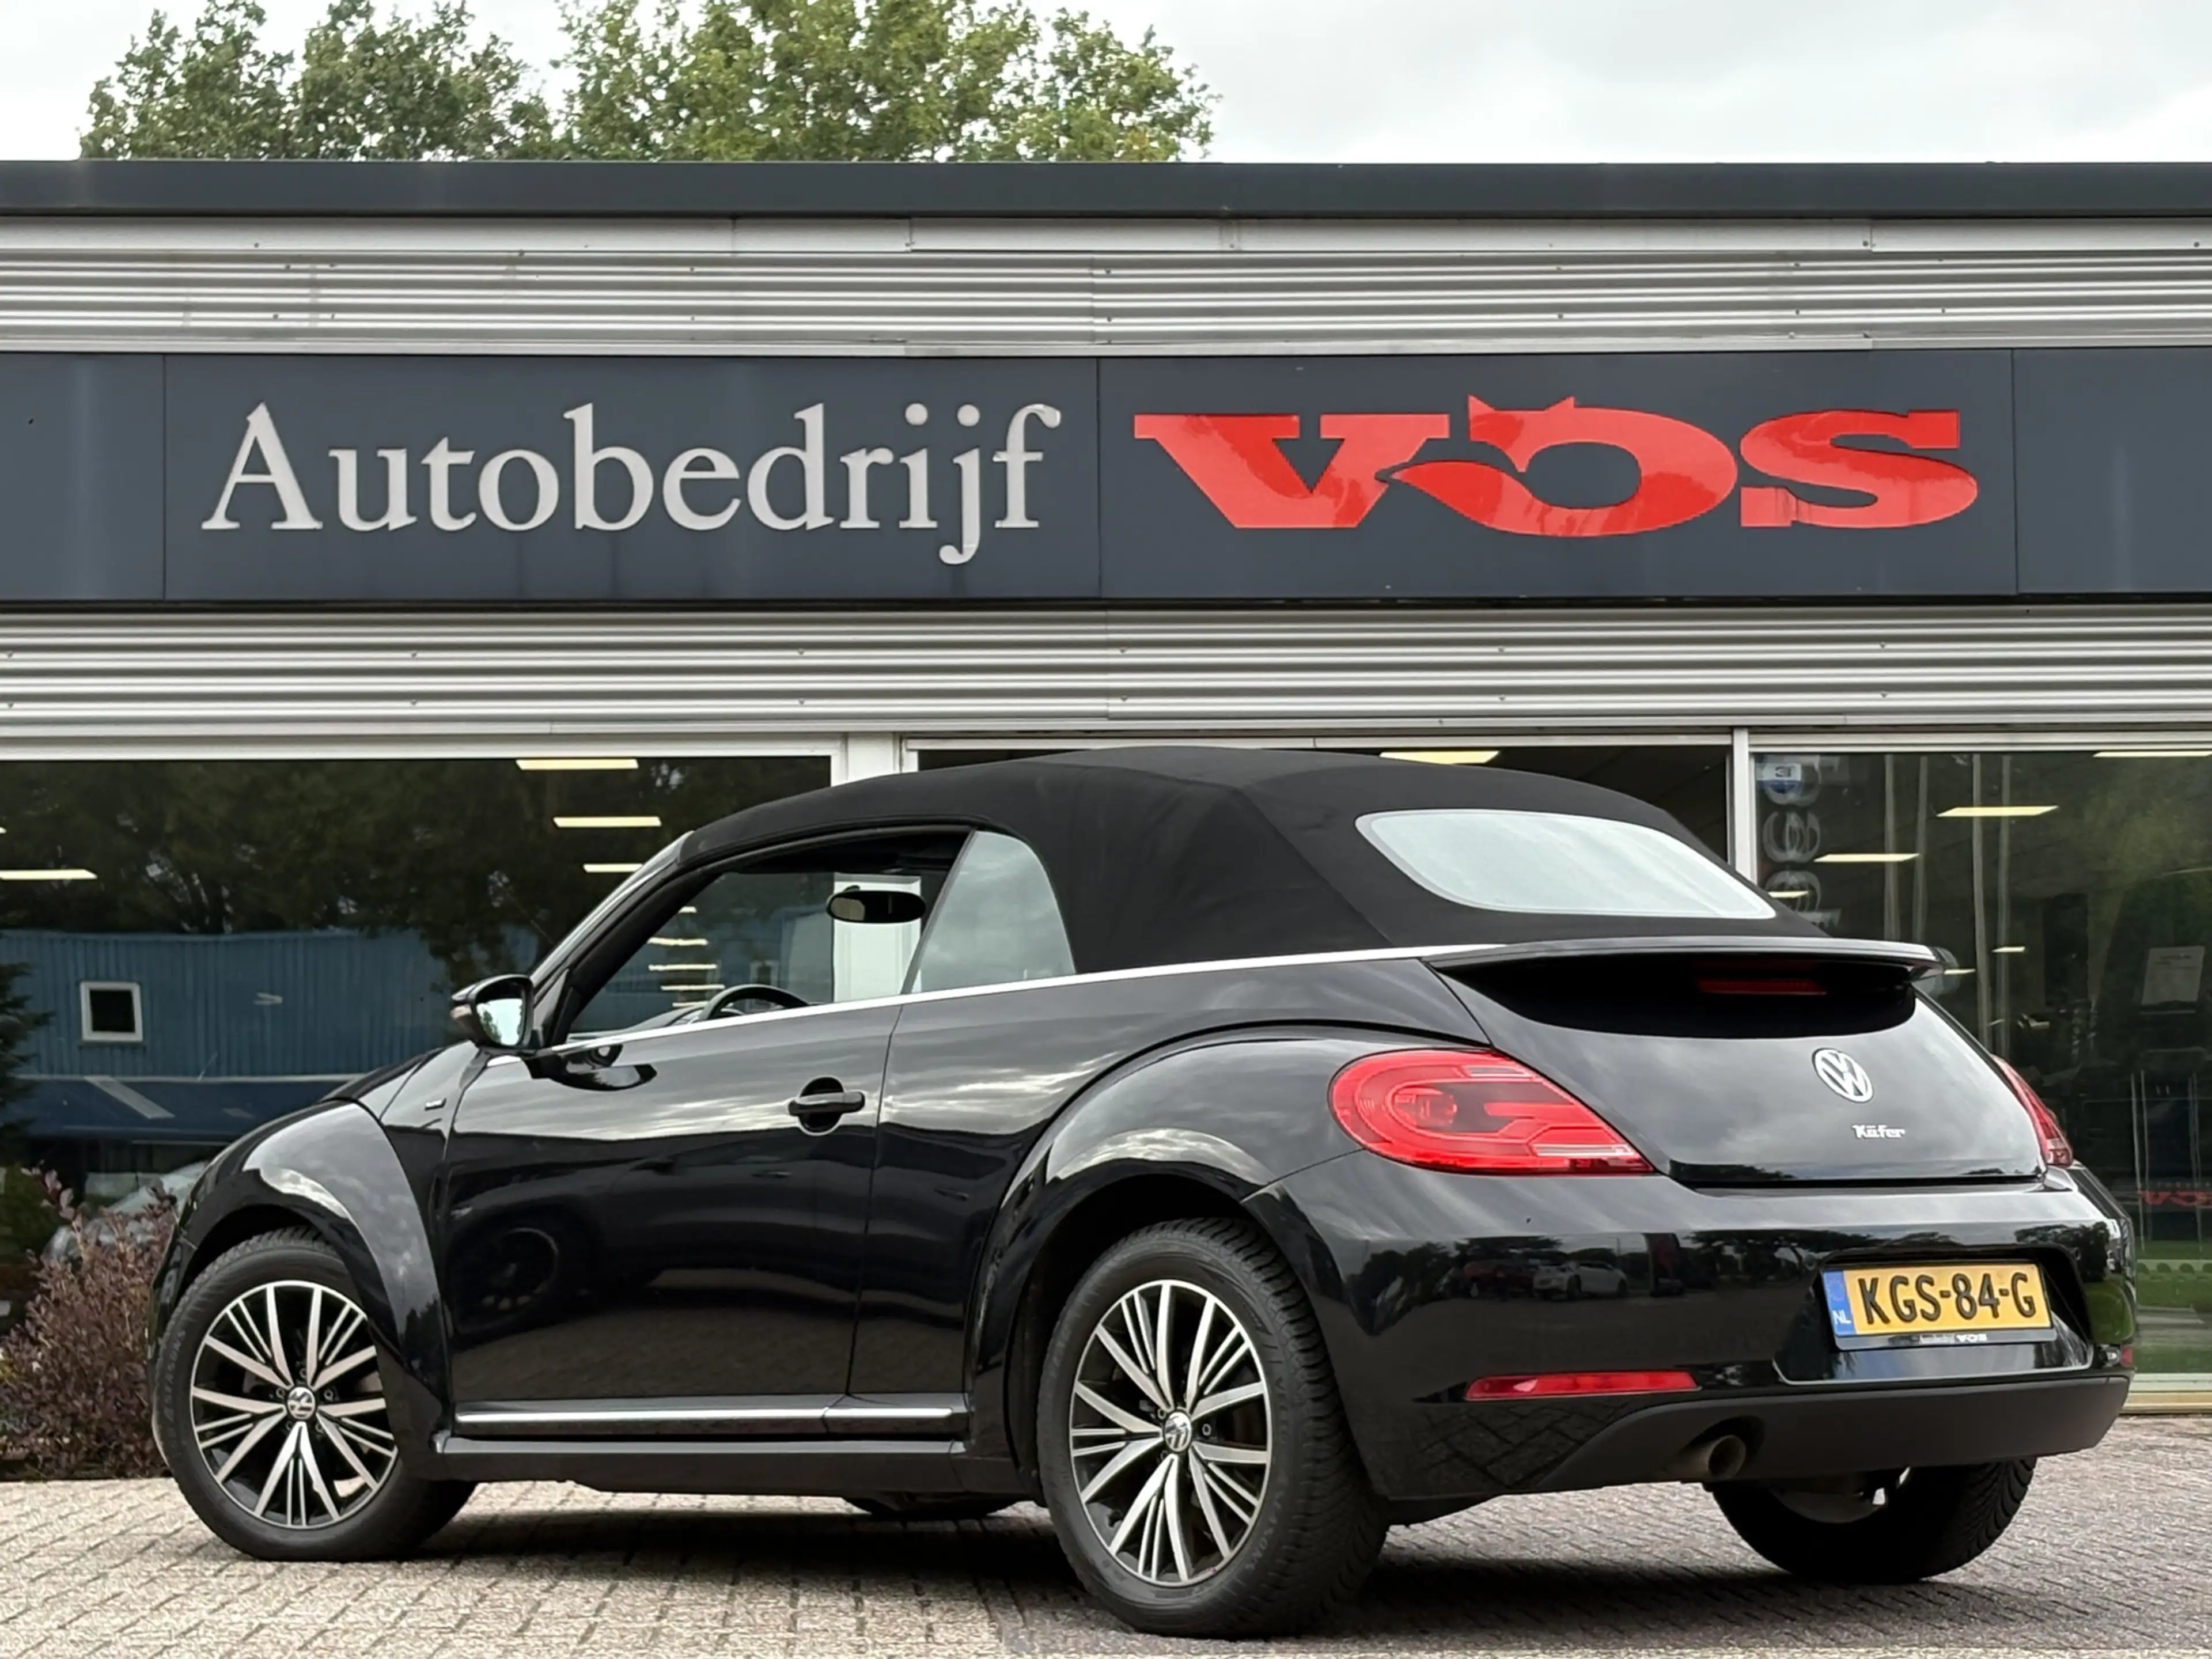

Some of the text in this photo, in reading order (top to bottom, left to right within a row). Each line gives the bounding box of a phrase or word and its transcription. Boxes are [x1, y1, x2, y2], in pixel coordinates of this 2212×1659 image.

[202, 395, 1978, 565] Autobedrijf VOS
[1852, 1124, 1906, 1139] Käfer
[1858, 1272, 2037, 1325] KGS-84-G
[1832, 1309, 1851, 1325] NL
